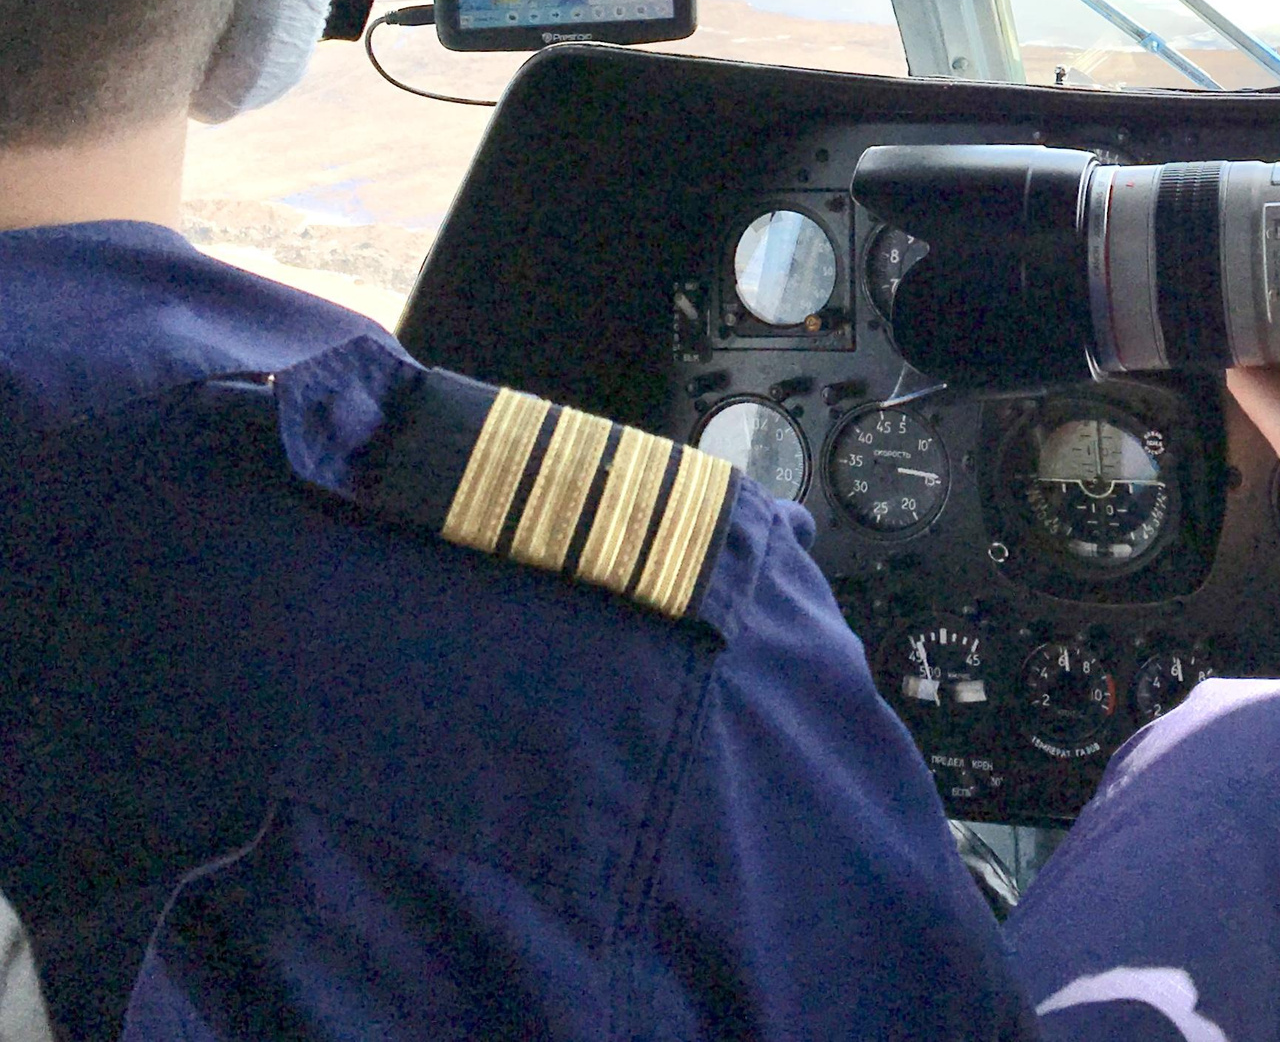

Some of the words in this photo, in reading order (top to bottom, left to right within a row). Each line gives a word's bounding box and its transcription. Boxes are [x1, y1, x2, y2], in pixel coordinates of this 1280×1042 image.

[890, 249, 900, 264] 8
[890, 278, 902, 293] 7
[876, 421, 892, 434] 45
[898, 422, 907, 434] 5
[858, 432, 873, 444] 40
[918, 439, 929, 451] 10
[848, 454, 863, 467] 35
[873, 449, 912, 459] СКОРОСТЬ
[775, 467, 793, 481] 20
[853, 479, 868, 493] 30
[873, 501, 889, 514] 25
[901, 497, 916, 511] 20
[965, 654, 981, 666] 45
[1040, 666, 1048, 679] 4
[1082, 660, 1090, 674] 8
[1171, 664, 1179, 676] 6
[1153, 676, 1161, 689] 4
[1042, 693, 1051, 706] 2
[1091, 688, 1102, 702] 10
[1153, 703, 1162, 717] 2
